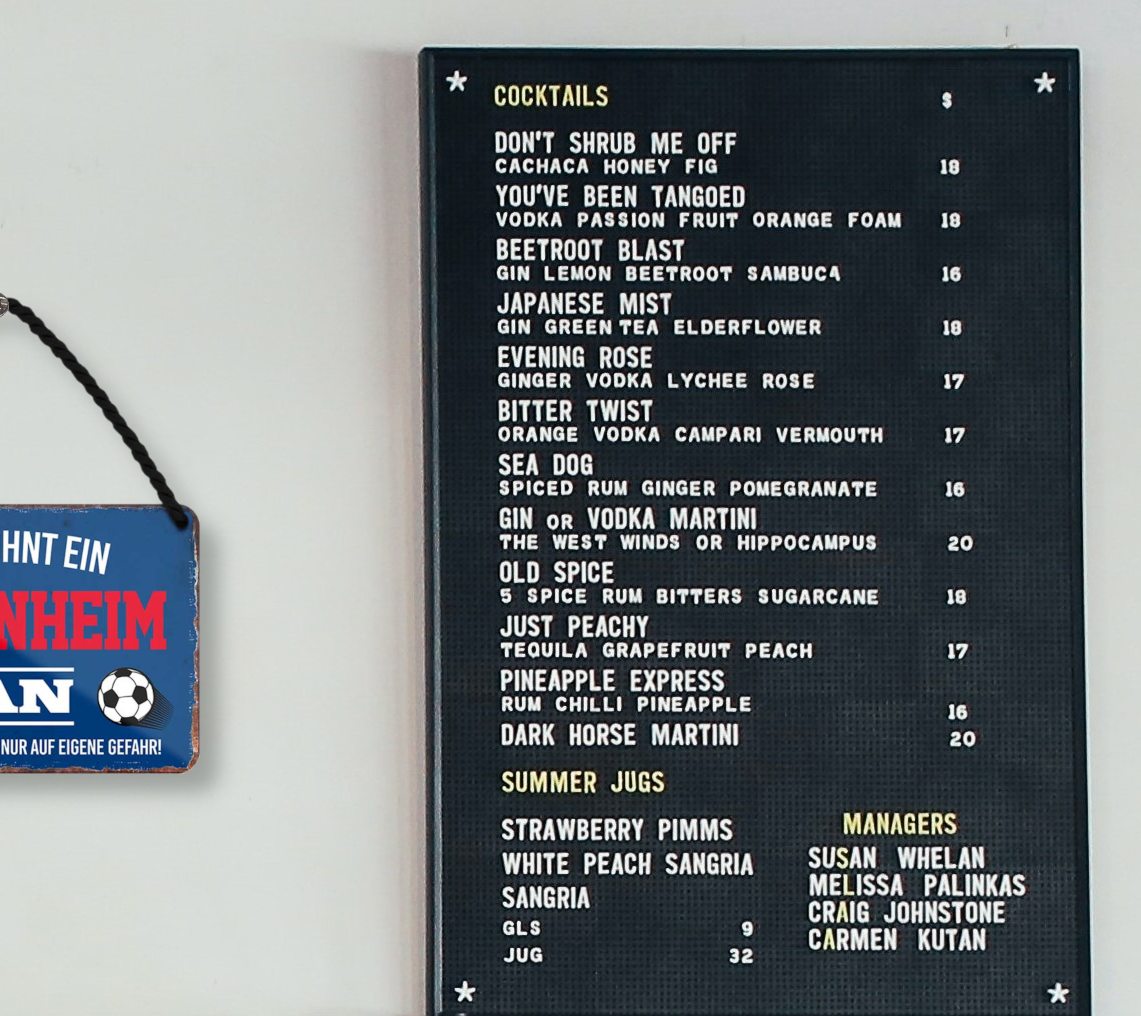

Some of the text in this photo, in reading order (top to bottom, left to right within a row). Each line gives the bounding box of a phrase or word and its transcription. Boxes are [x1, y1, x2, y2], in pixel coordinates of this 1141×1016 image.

[494, 84, 609, 107] COCKTAILS
[494, 130, 737, 155] DON'T SHRUB ME OFF
[495, 157, 960, 176] CACHACA HONEY FIG 18
[495, 183, 746, 209] YOU'VE BEEN TANGOED
[495, 211, 961, 229] VODKA PASSION FRUIT ORANGE FOAM 18
[496, 238, 685, 262] BEETROOT BLAST
[496, 265, 530, 282] GIN
[544, 265, 612, 282] LEMON
[625, 265, 733, 282] BEETROOT
[941, 266, 962, 283] 16
[496, 291, 672, 316] JAPANESE MIST
[497, 318, 962, 336] GIN GREEN TEA ELDERFLOWER 18
[497, 345, 653, 370] EVENING ROSE
[497, 372, 965, 390] GINGER VODKA LYCHEE ROSE 17
[498, 399, 653, 423] BITTER TWIST
[497, 425, 966, 444] ORANGE VODKA CAMPARI VERMOUTH 17
[498, 453, 594, 476] SEA DOG
[499, 479, 965, 498] SPICED RUM GINGER POMEGRANATE 16
[499, 506, 757, 531] GIN OR VODKA MARTINI
[63, 534, 111, 575] EIN
[499, 533, 974, 552] THE WEST WINDS OR HIPPOCAMPUS 20
[499, 560, 615, 584] OLD SPICE
[499, 587, 967, 606] 5 SPICE RUM BITTERS SUGARCANE 18
[499, 614, 649, 638] JUST PEACHY
[500, 641, 969, 660] TEQUILA GRAPEFRUIT PEACH 17
[500, 668, 725, 693] PINEAPPLE EXPRESS
[501, 695, 752, 713] RUM CHILLI PINEAPPLE
[947, 703, 968, 721] 16
[501, 722, 739, 747] DARK HORSE MARTINI
[949, 730, 977, 748] 20
[0, 738, 28, 756] NUR
[30, 738, 55, 756] AUF
[59, 738, 104, 756] EIGENE
[108, 738, 162, 756] GEFAHR!
[501, 770, 665, 794] SUMMER JUGS
[501, 817, 734, 842] STRAWBERRY PIMMS
[843, 812, 958, 836] MANAGERS
[502, 851, 754, 876] WHITE PEACH SANGRIA
[808, 845, 985, 870] SUSAN WHELAN
[809, 873, 1027, 897] MELISSA PALINKAS
[502, 885, 591, 910] SANGRIA
[808, 900, 1006, 924] CRAIG JOHNSTONE
[502, 920, 754, 937] GLS 9
[808, 927, 987, 952] CARMEN KUTAN
[503, 946, 754, 964] JUG 32
